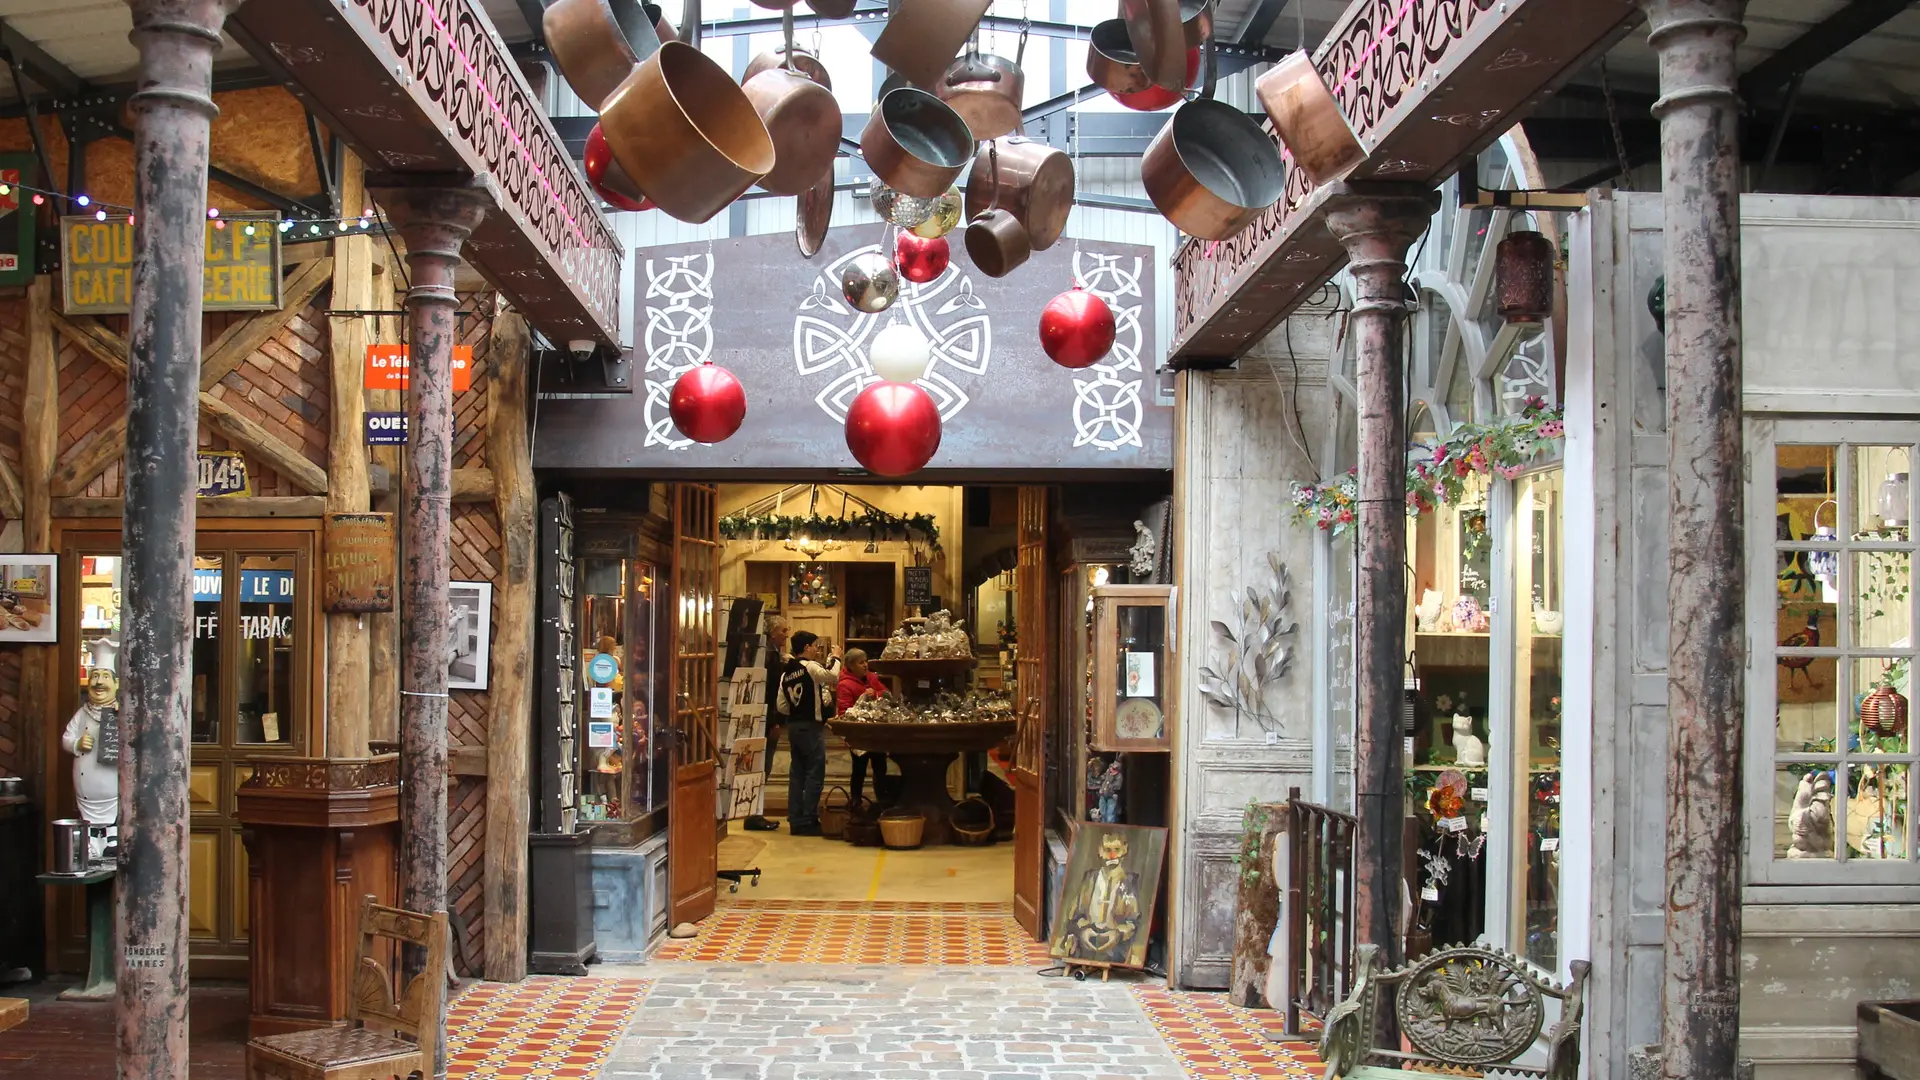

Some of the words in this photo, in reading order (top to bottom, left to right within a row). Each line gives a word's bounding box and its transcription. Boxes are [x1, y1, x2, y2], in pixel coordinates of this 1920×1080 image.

[70, 222, 224, 264] COUC
[372, 355, 387, 367] Le
[254, 577, 270, 596] LE
[241, 616, 293, 639] TABAC
